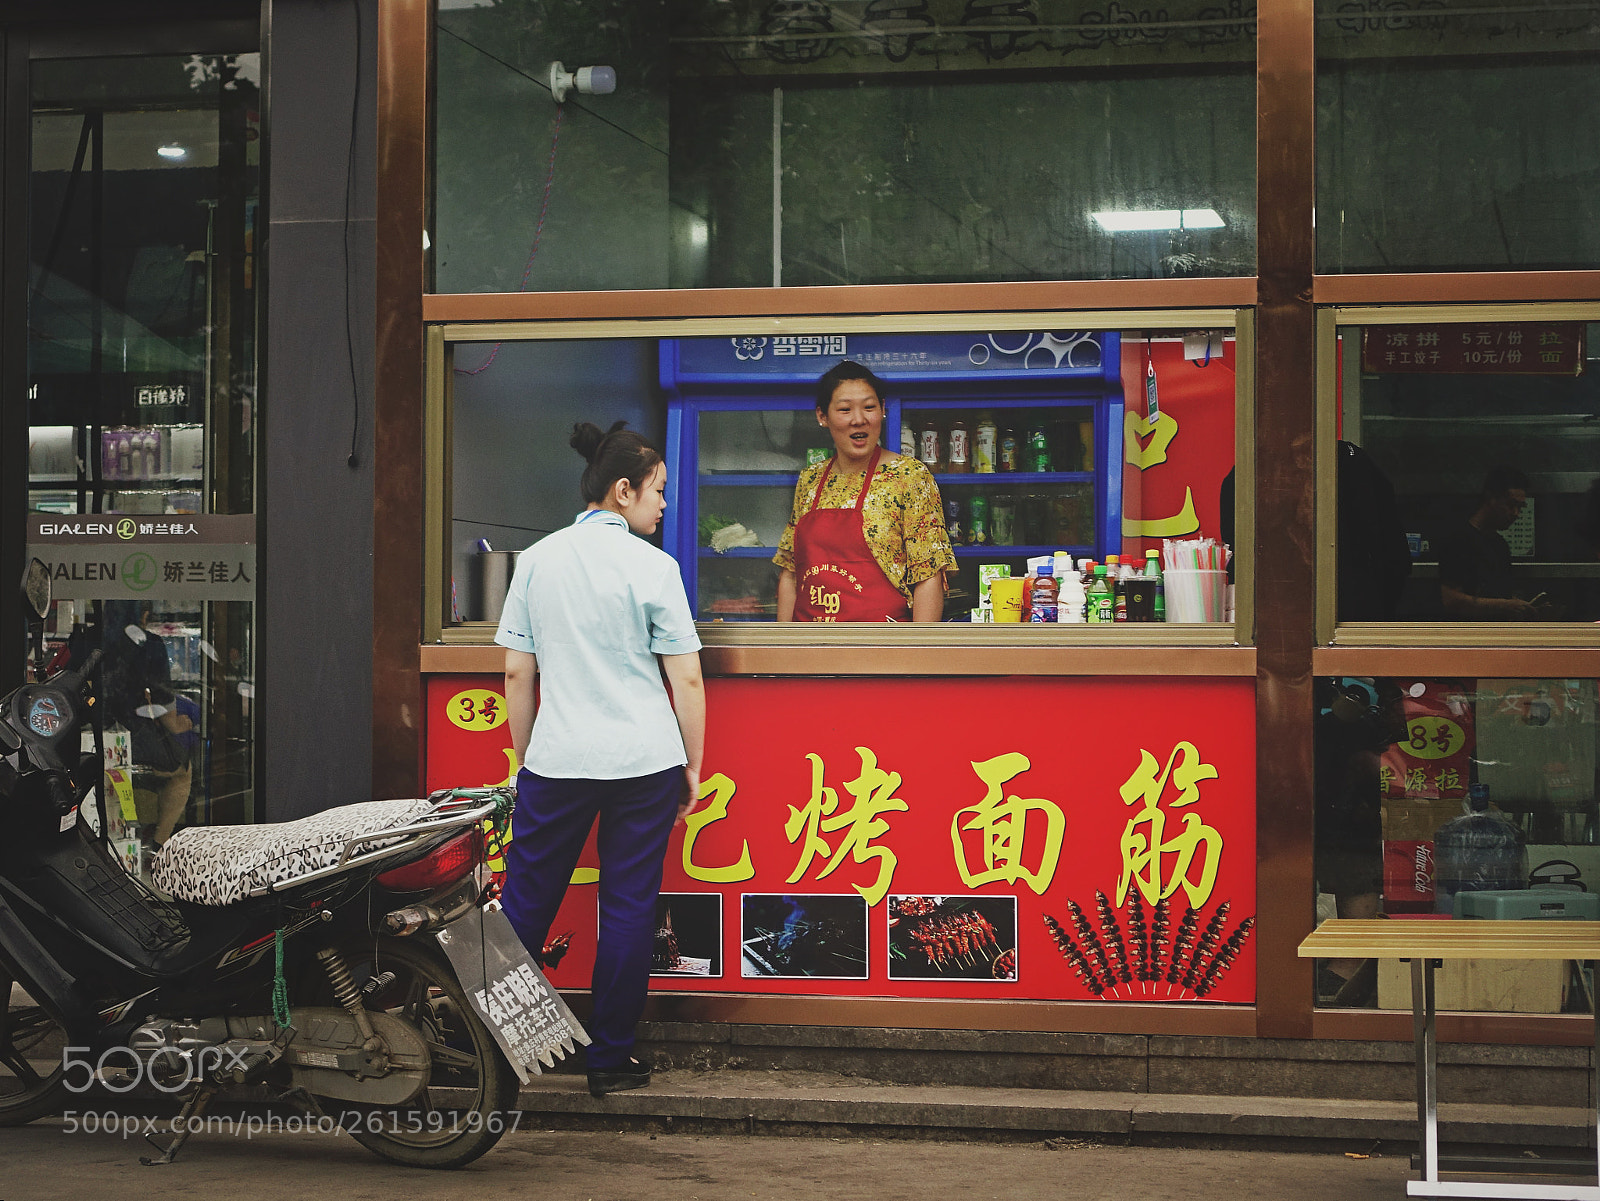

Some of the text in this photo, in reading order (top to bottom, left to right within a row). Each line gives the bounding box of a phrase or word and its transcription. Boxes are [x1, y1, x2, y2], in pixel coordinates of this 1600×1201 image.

[1385, 350, 1523, 366] 手工饺子 10元/份
[40, 523, 199, 536] GIALEN 娇兰佳人
[163, 560, 251, 584] 娇兰佳人
[458, 697, 500, 725] 3号
[1410, 724, 1453, 753] 8号
[500, 998, 561, 1048] 摩托车行
